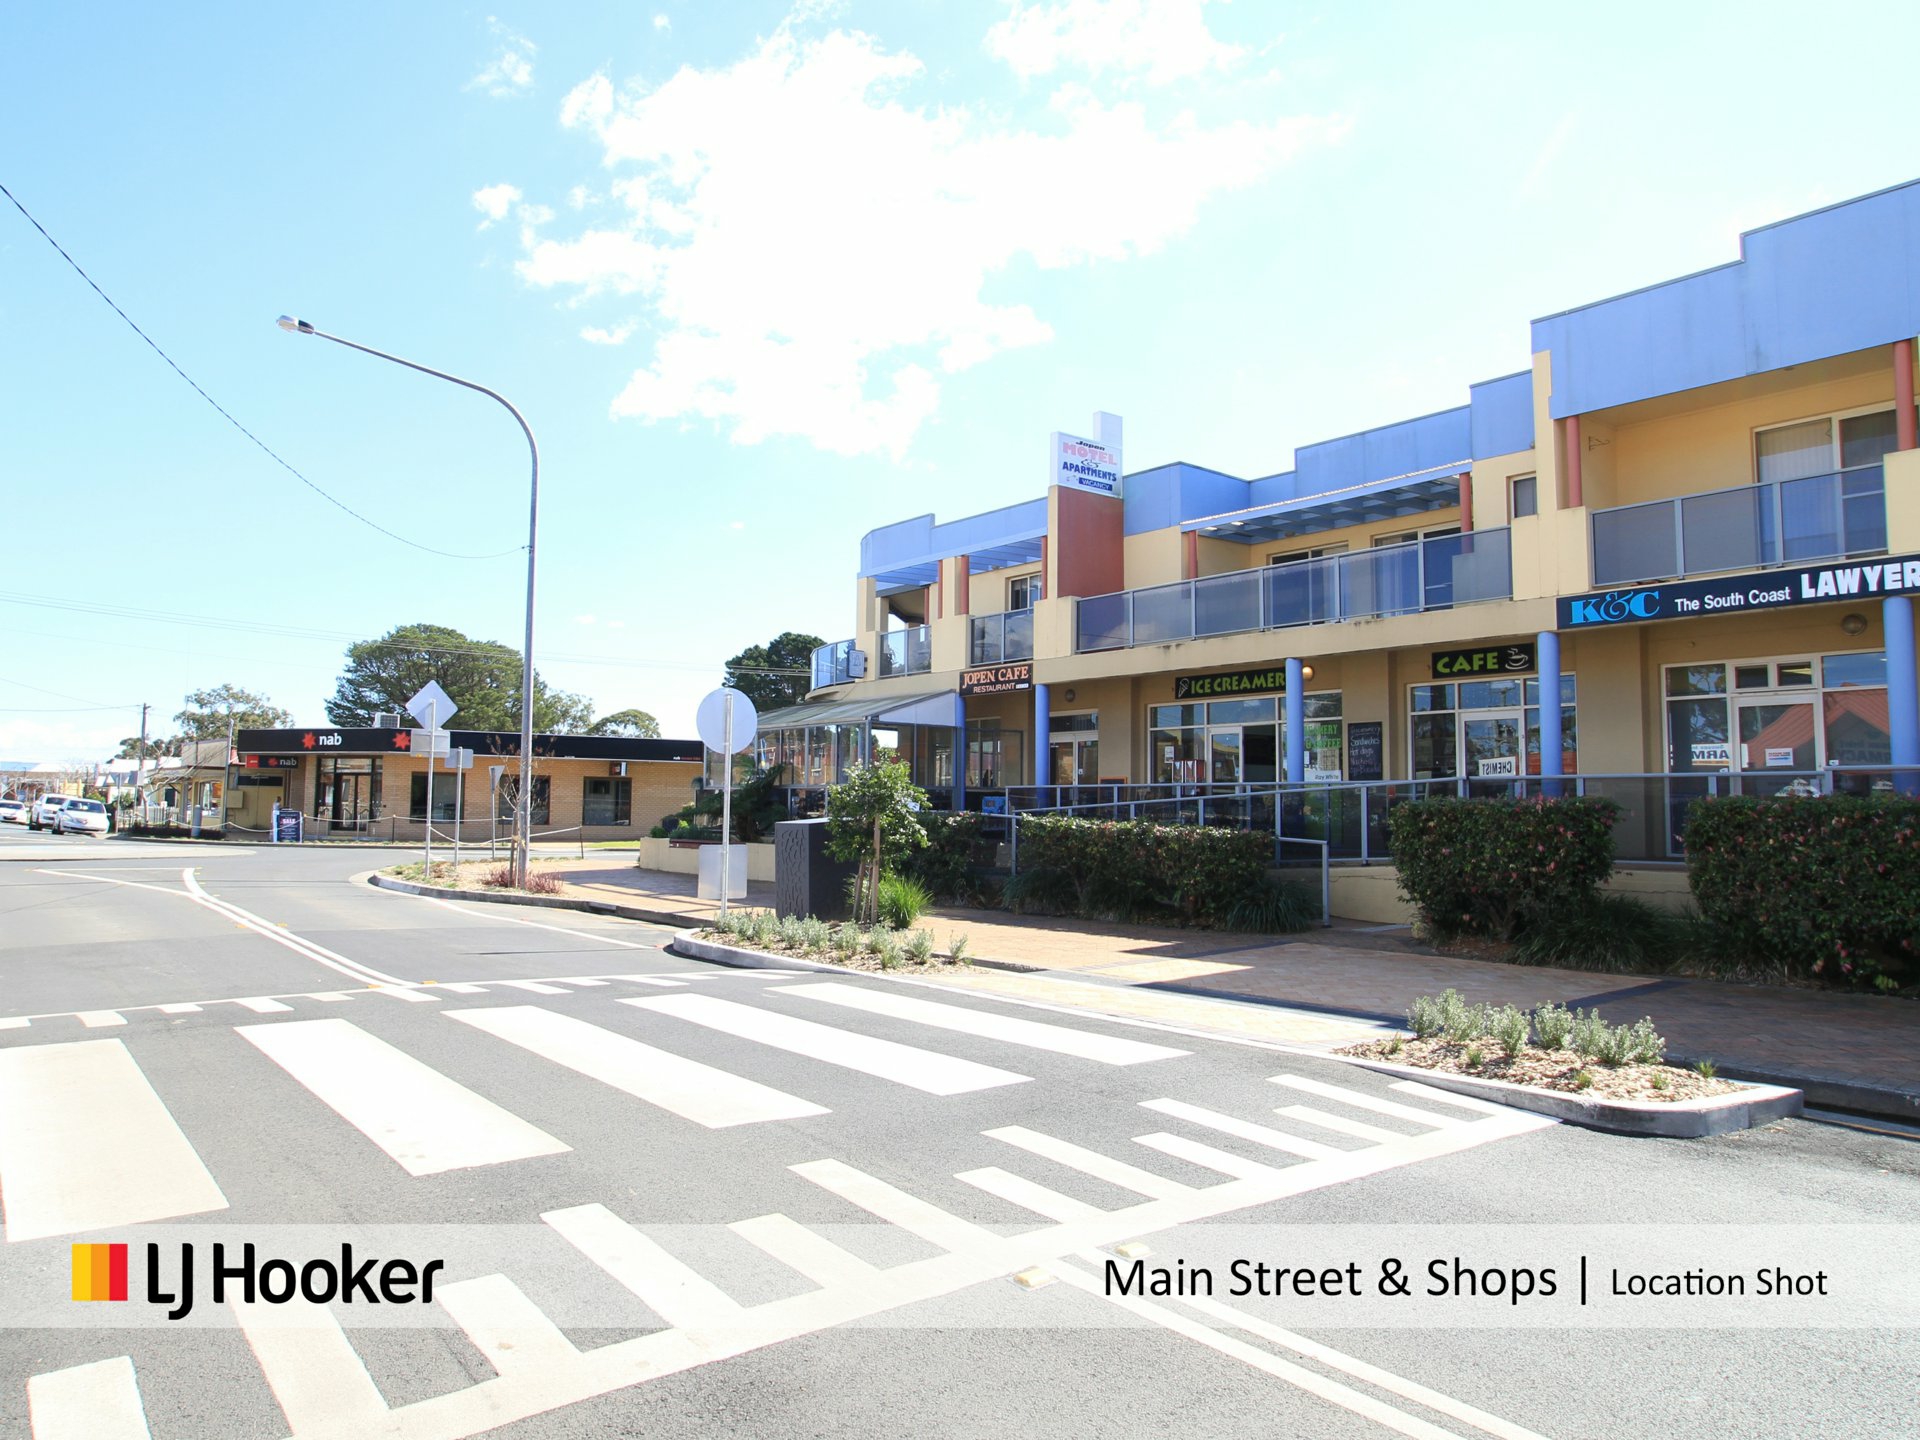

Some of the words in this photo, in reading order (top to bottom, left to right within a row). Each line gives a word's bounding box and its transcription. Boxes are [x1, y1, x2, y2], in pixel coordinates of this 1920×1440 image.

[1062, 441, 1117, 465] MOTEL
[1062, 461, 1117, 481] APARTMENTS
[1081, 479, 1110, 490] VACANCY
[1570, 591, 1660, 624] K&C
[1675, 597, 1700, 612] The
[1704, 591, 1744, 610] South
[1749, 586, 1791, 604] Coast
[1437, 651, 1499, 674] CAFE
[963, 670, 995, 688] JOPEN
[998, 666, 1029, 681] CAFE
[973, 682, 1015, 693] RESTAURANT
[1191, 679, 1212, 694] ICE
[319, 732, 342, 746] nab
[279, 757, 297, 766] nab
